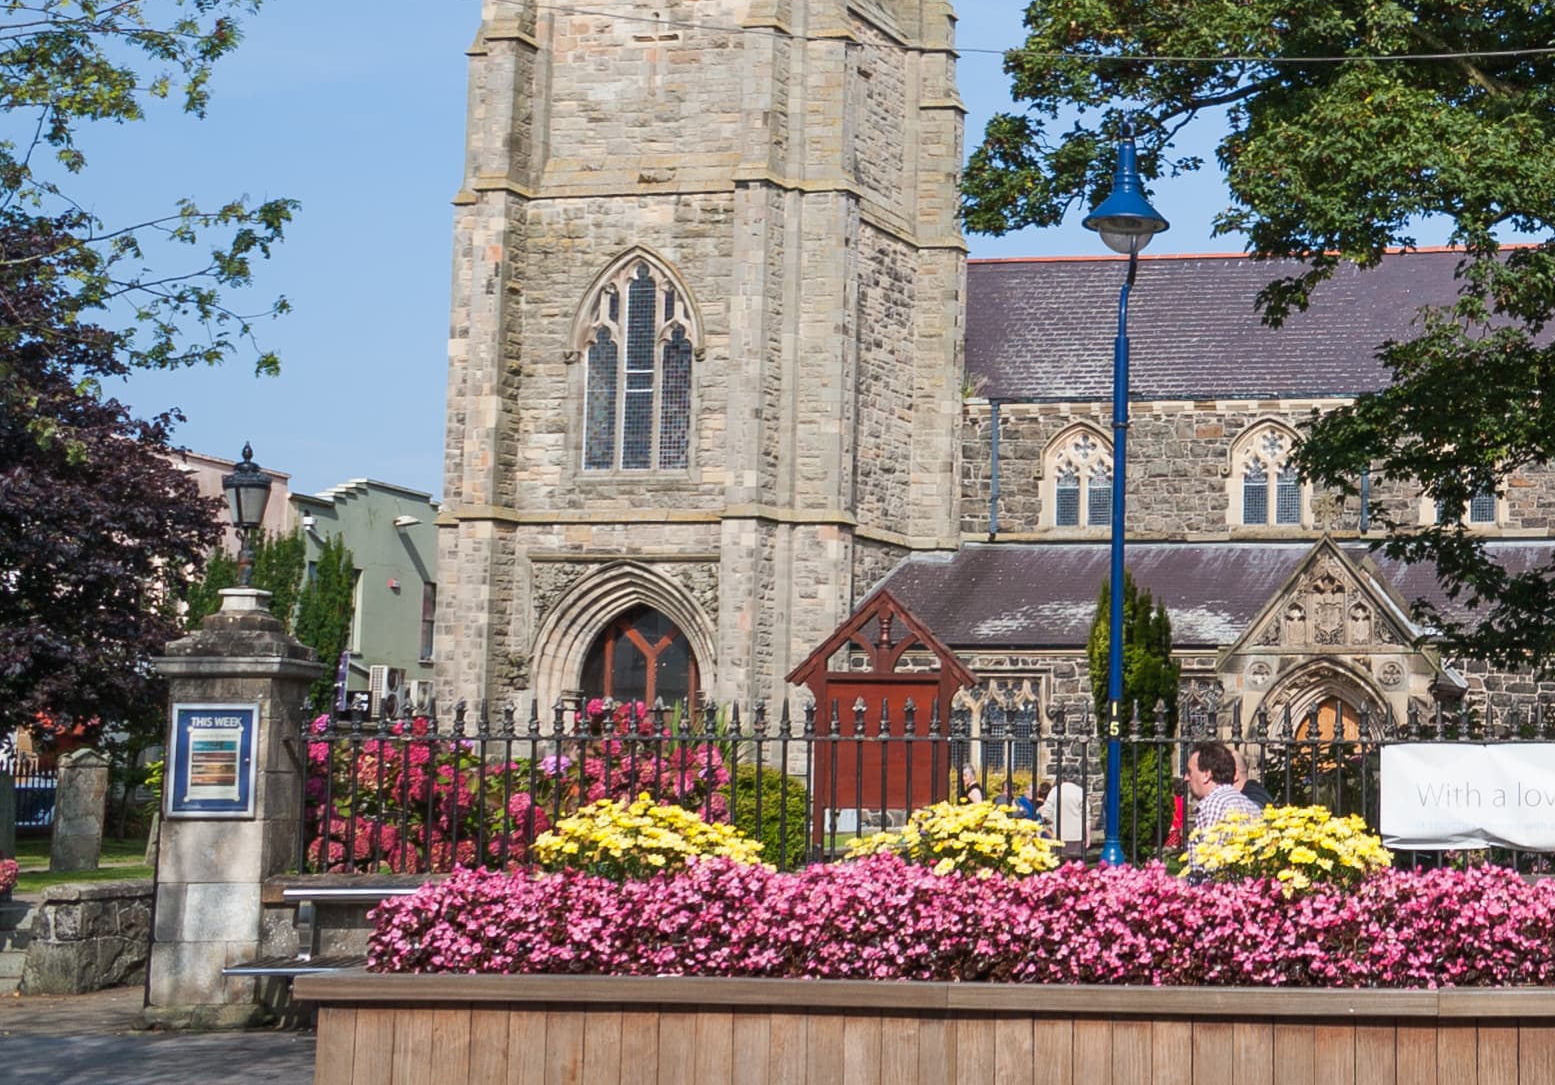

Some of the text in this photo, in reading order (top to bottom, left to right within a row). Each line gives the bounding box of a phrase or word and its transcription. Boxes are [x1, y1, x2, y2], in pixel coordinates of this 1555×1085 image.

[191, 716, 242, 727] THIS WEEK
[1416, 781, 1482, 807] With
[1492, 788, 1506, 807] a
